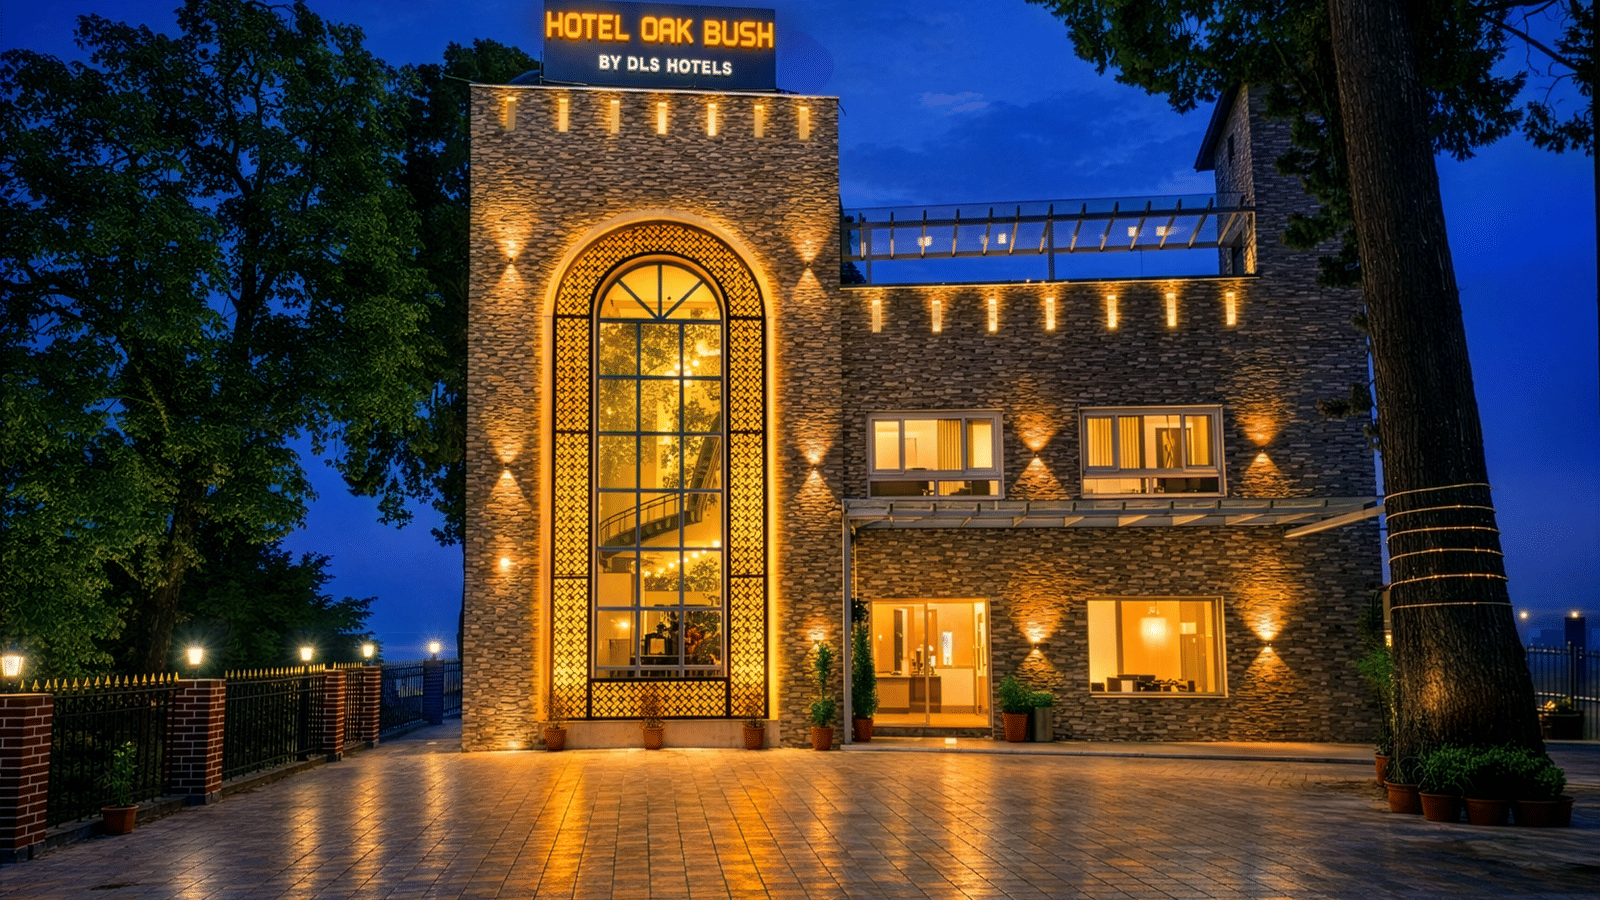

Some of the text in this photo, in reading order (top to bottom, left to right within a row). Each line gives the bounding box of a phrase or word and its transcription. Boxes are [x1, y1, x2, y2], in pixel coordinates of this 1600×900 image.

[546, 11, 774, 48] HOTEL OAK BUSH
[599, 55, 733, 76] BY DLS HOTELS
